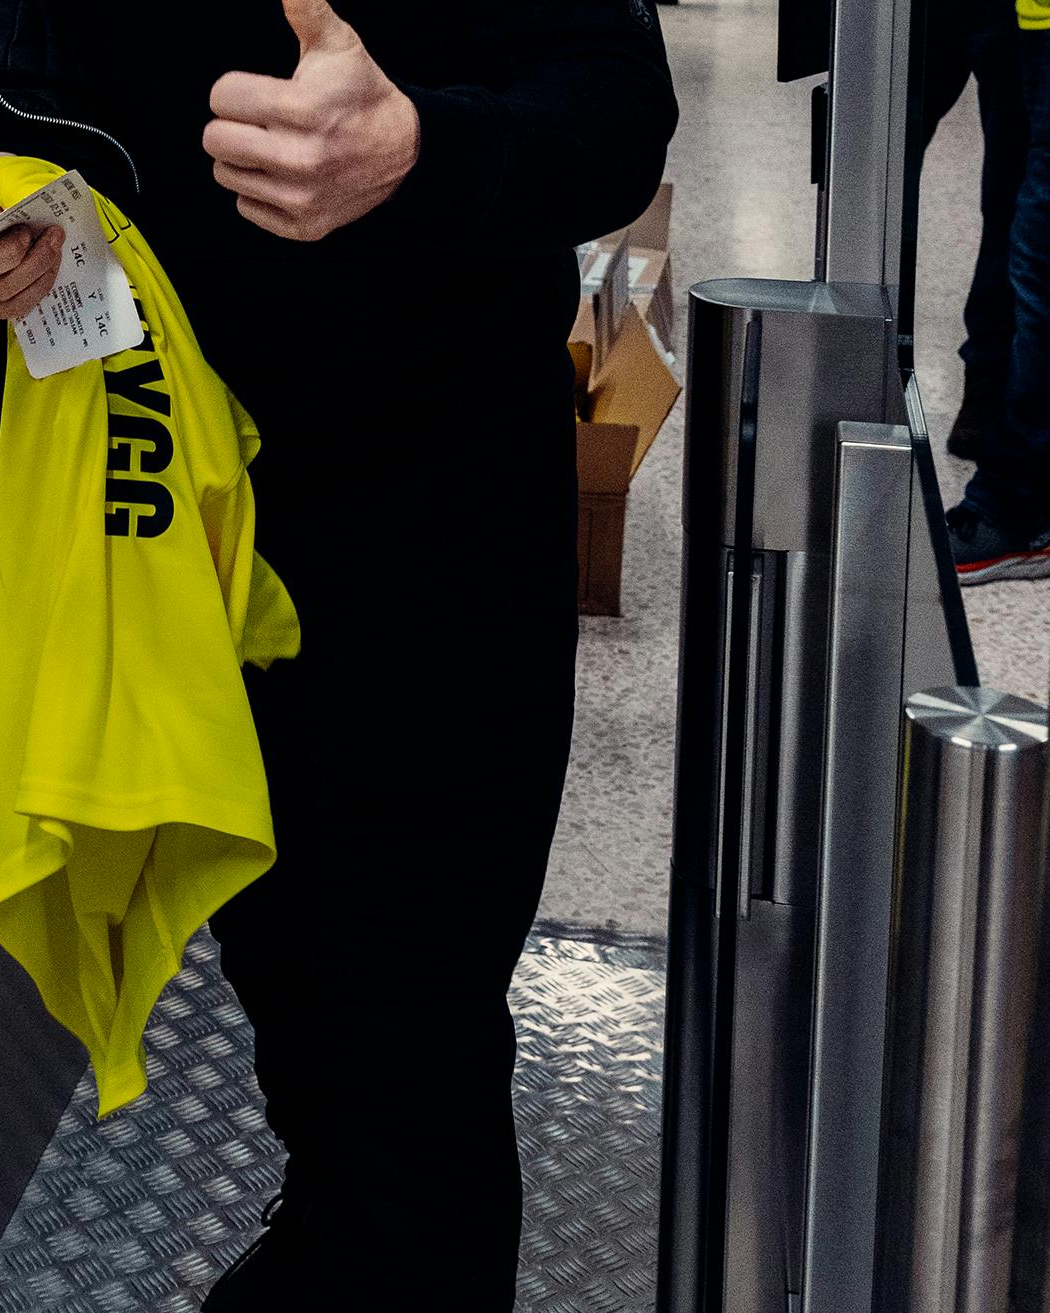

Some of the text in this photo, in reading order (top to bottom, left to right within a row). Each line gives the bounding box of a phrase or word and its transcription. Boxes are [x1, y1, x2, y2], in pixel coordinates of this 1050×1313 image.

[71, 245, 86, 267] 14C
[69, 281, 84, 308] ECONOMY
[94, 314, 109, 337] 14C
[104, 294, 175, 538] YGG
